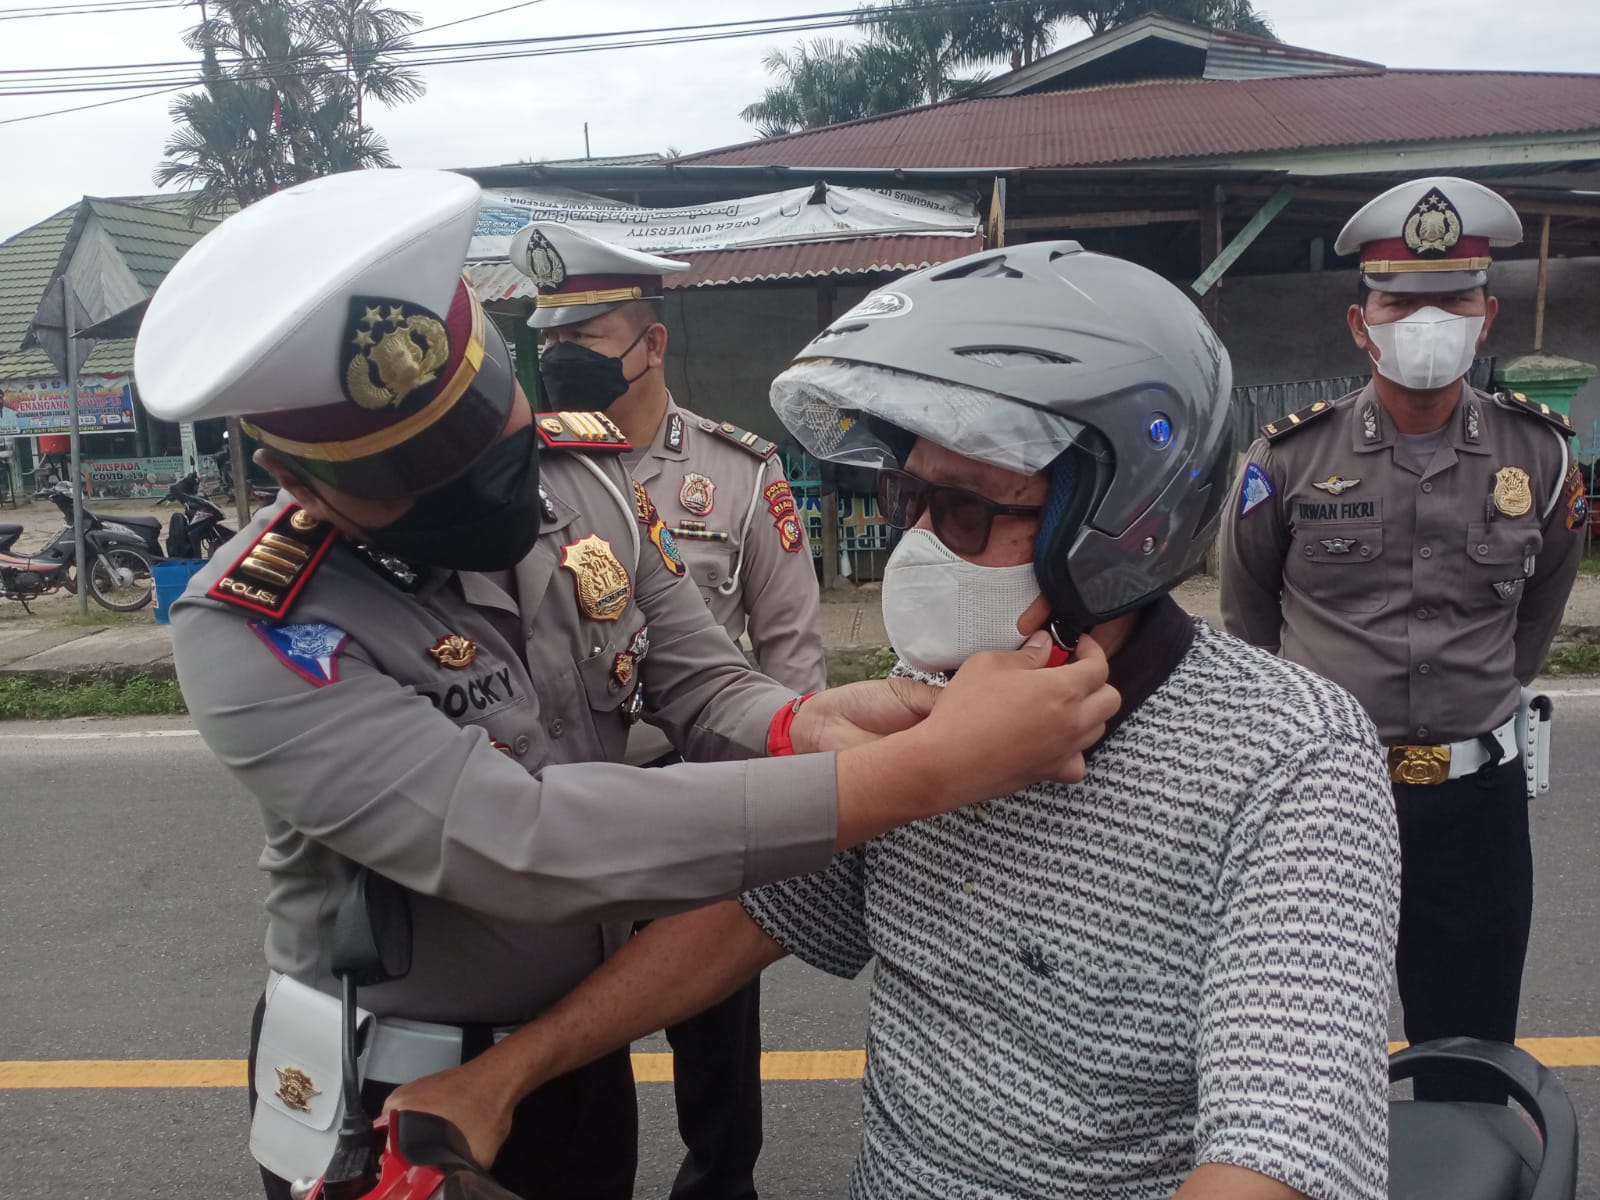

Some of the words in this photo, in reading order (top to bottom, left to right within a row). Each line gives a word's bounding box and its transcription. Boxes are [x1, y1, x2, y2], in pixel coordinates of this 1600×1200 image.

[894, 191, 946, 211] PENGURUS
[532, 209, 570, 223] Baru
[571, 209, 649, 223] Mahasiswa
[627, 224, 712, 238] UNIVERSITY
[92, 462, 141, 472] WASPADA
[92, 472, 124, 481] COVID
[1341, 501, 1375, 519] FIKRI
